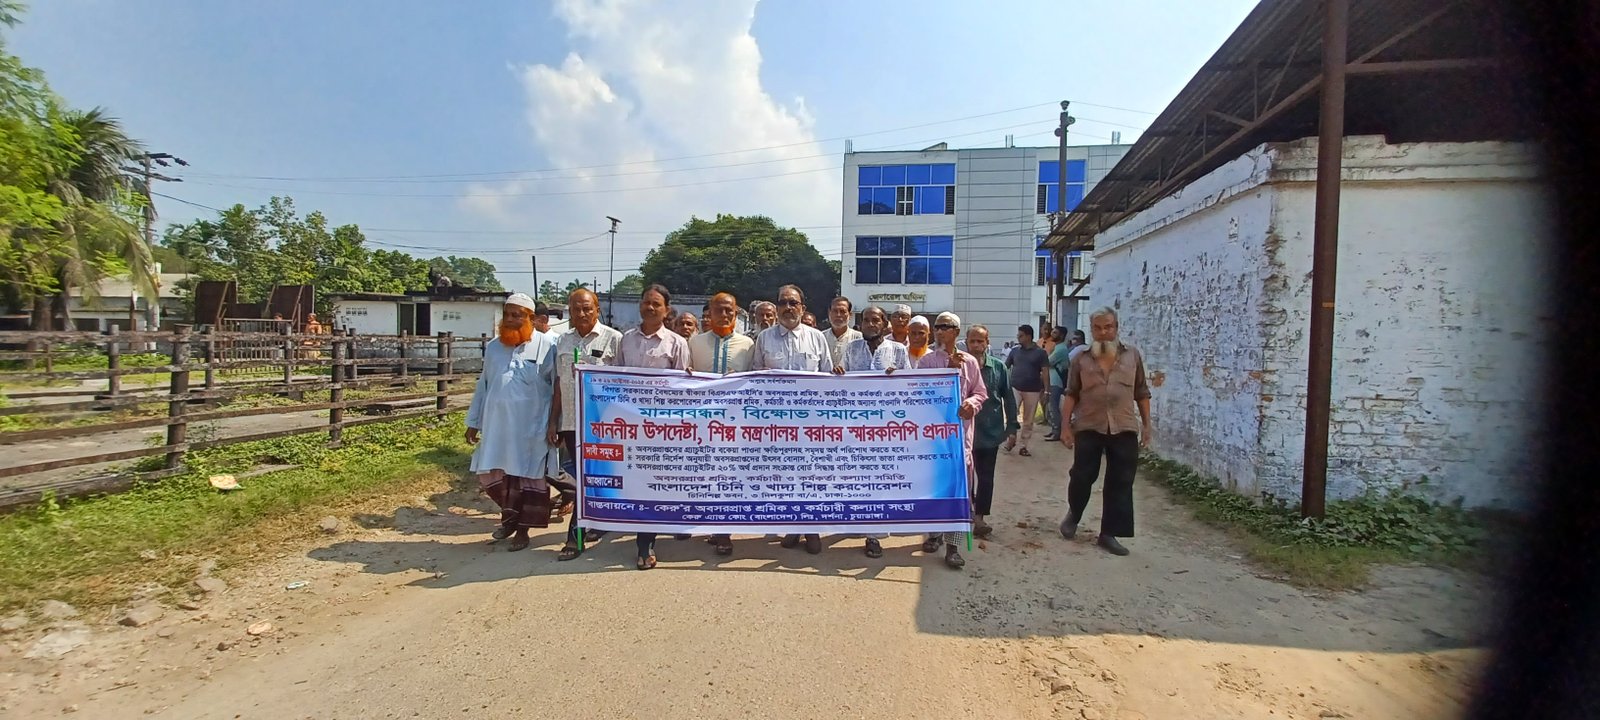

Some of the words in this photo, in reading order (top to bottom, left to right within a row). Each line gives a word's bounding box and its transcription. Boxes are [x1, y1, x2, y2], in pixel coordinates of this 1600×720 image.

[742, 405, 810, 420] বিক্ষোভ
[815, 408, 885, 420] সমাবেশ
[891, 409, 906, 419] ও
[590, 417, 639, 440] মাননীয়
[642, 419, 703, 445] উপদেষ্টা,
[707, 419, 737, 442] শিল্প
[740, 423, 799, 442] মন্ত্রণালয়
[803, 424, 844, 442] বরাবর
[847, 420, 919, 442] স্মারকলিপি
[922, 422, 959, 440] প্রদান
[859, 463, 880, 471] করতে
[874, 473, 906, 481] সমিতি
[647, 482, 712, 492] বাংলাদেশ
[717, 481, 745, 492] চিনি
[766, 483, 796, 492] খাদ্য
[801, 482, 829, 492] শিল্প
[832, 481, 912, 491] করপোরেশন
[755, 503, 788, 513] শ্রমিক
[804, 502, 846, 512] কর্মচারী
[849, 503, 885, 512] কল্যাণ
